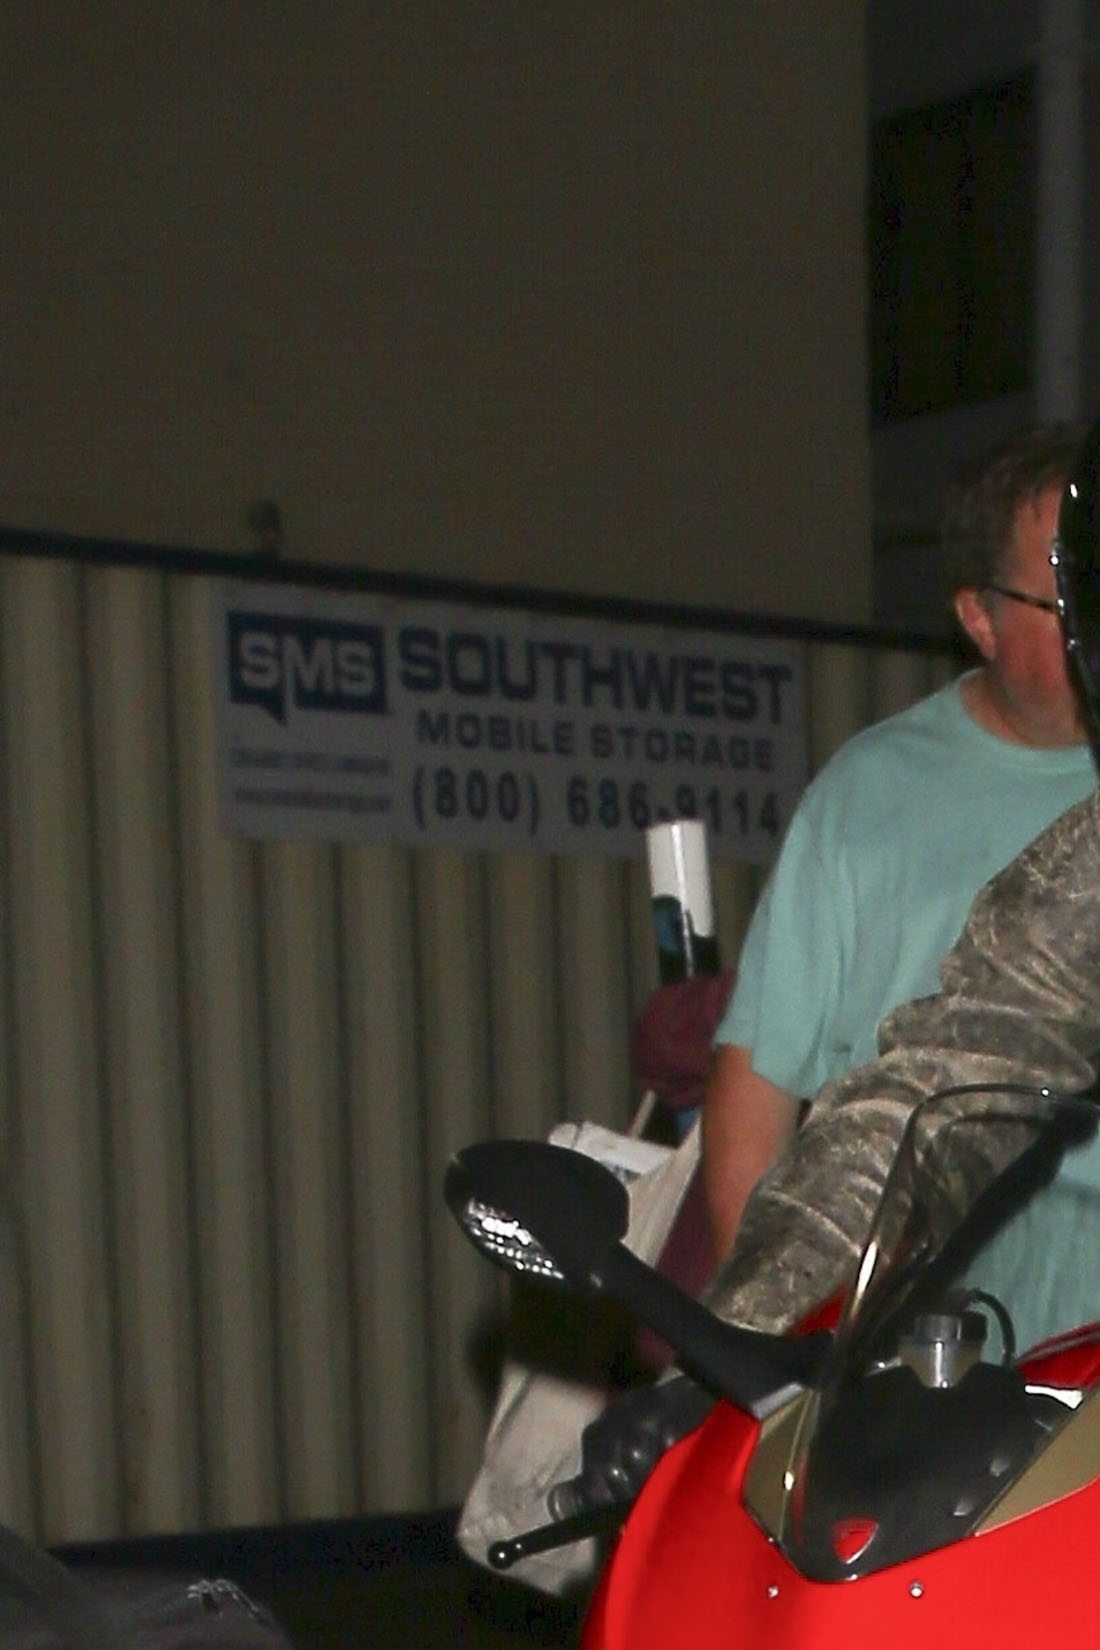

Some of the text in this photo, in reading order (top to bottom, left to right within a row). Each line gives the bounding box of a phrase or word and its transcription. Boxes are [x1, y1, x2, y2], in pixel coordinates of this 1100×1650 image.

[240, 626, 793, 725] SMS SOUTHWEST
[418, 711, 774, 770] MOBILE STORAGE
[413, 766, 540, 834] (800)
[567, 776, 779, 836] 686-9114
